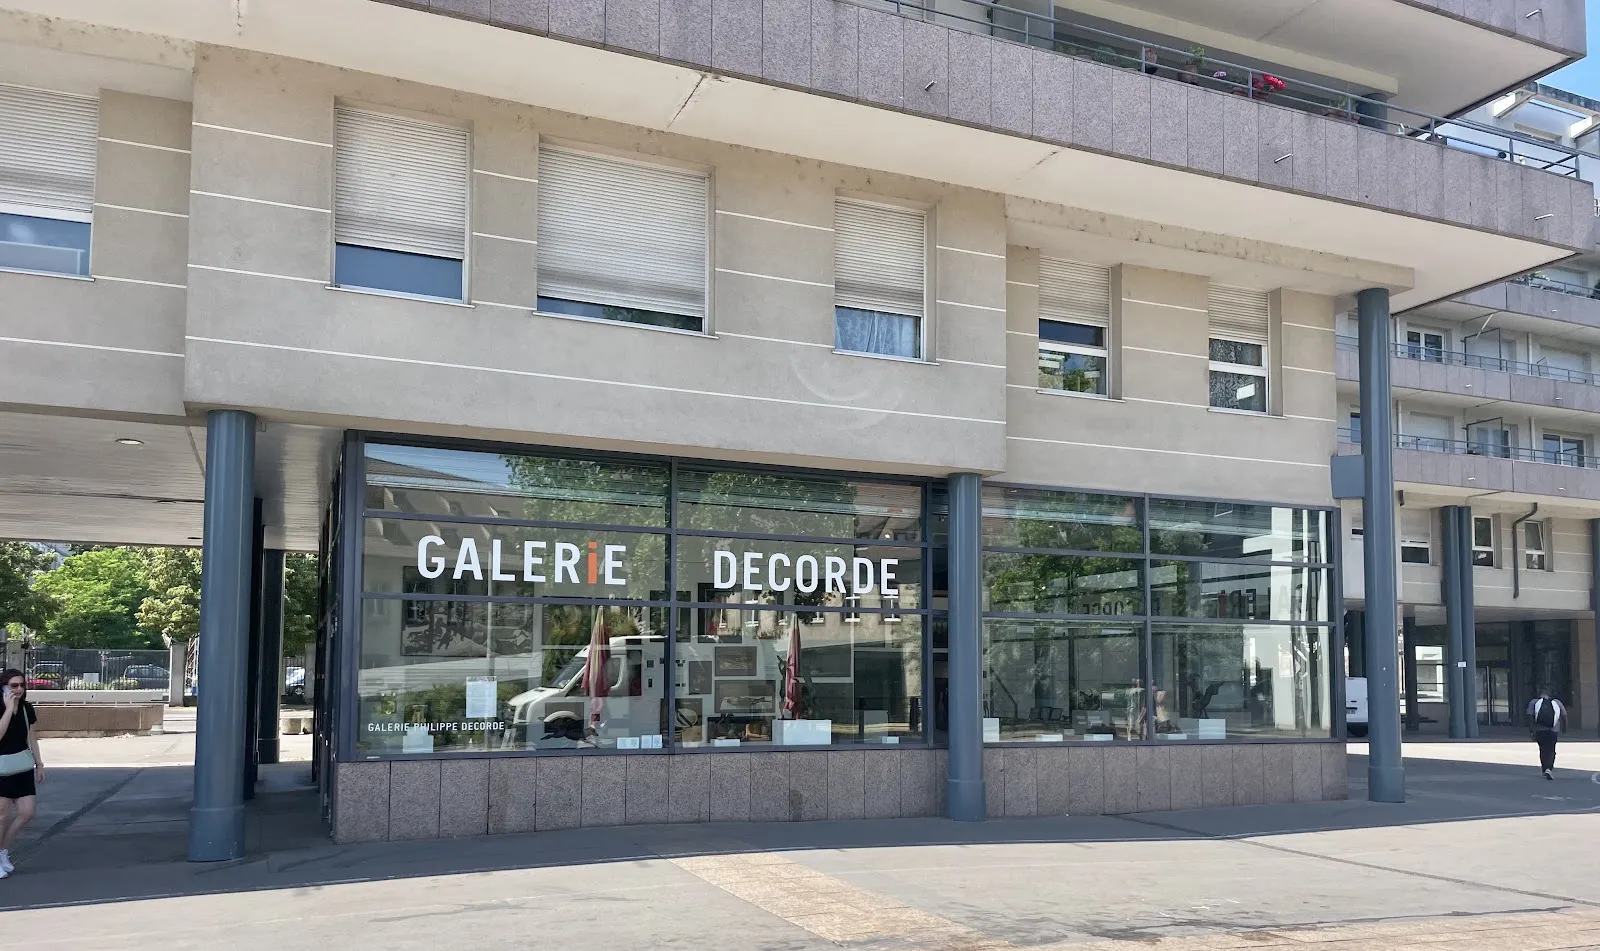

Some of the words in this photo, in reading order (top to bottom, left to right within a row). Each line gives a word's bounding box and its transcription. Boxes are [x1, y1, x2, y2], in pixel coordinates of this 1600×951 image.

[713, 550, 899, 596] DECORDE
[367, 722, 409, 732] GALERIE
[413, 722, 457, 731] PHILIPPE
[461, 721, 505, 731] DECORDE
